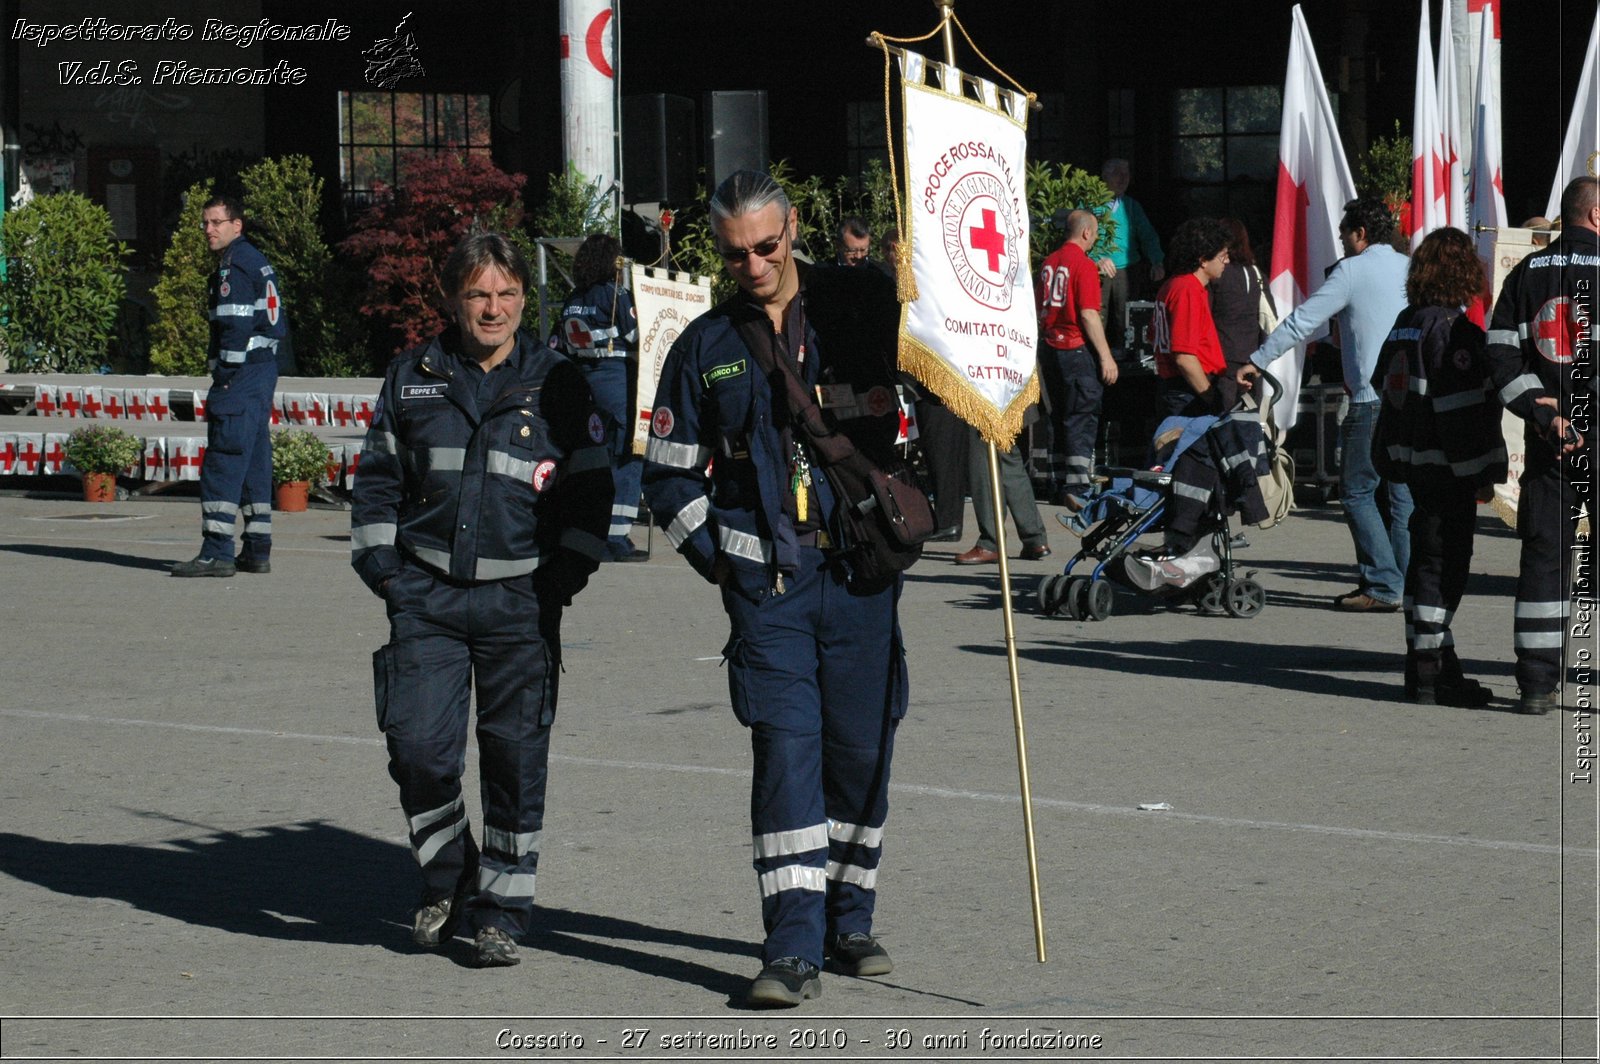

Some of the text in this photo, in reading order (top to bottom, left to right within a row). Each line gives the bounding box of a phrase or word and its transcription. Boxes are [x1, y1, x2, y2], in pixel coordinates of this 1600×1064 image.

[924, 152, 953, 215] CROCE
[949, 141, 997, 164] ROSSA
[945, 317, 1006, 338] COMITATO
[996, 344, 1008, 358] DI
[967, 364, 1023, 386] GATTINARA
